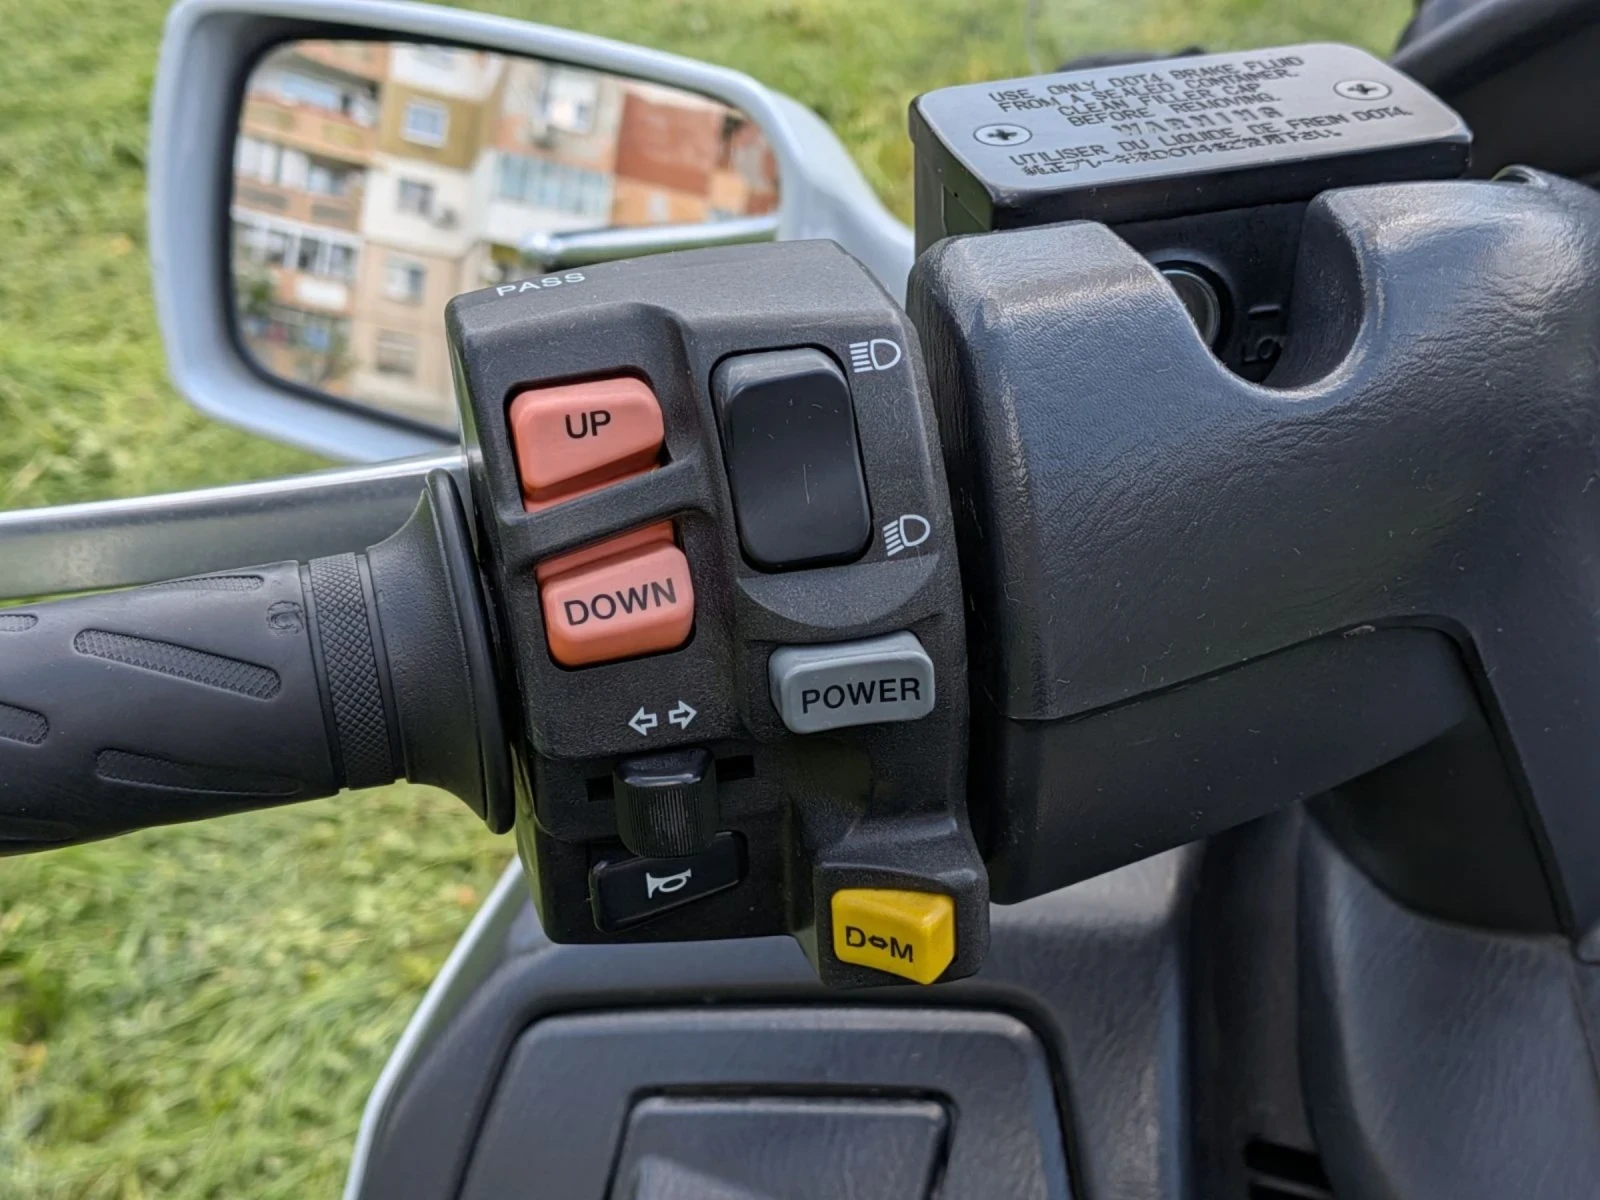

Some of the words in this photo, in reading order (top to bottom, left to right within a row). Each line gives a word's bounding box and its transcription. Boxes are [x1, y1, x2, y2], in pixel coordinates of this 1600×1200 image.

[988, 89, 1035, 103] USE
[1046, 80, 1097, 96] ONLY
[1108, 72, 1164, 89] DOT4
[1168, 63, 1240, 81] BRAKE
[1243, 56, 1305, 72] FLUID
[998, 97, 1062, 113] FROM
[1070, 93, 1086, 104] A
[1092, 83, 1175, 101] SEALED
[1185, 69, 1299, 90] CONTAINER.
[1058, 99, 1131, 117] CLEAN
[1139, 89, 1211, 107] FILLER
[1222, 83, 1261, 96] CAP
[1068, 107, 1156, 127] BEFORE
[1168, 92, 1282, 115] REMOVING.
[1009, 144, 1110, 167] UTILISER
[1117, 139, 1151, 151] DU
[1158, 127, 1241, 147] LIQUIDE
[1247, 122, 1281, 135] DE
[1286, 113, 1350, 130] FREIN
[495, 272, 586, 297] PASS
[565, 409, 612, 439] UP
[564, 578, 677, 626] DOWN
[802, 677, 921, 714] POWER
